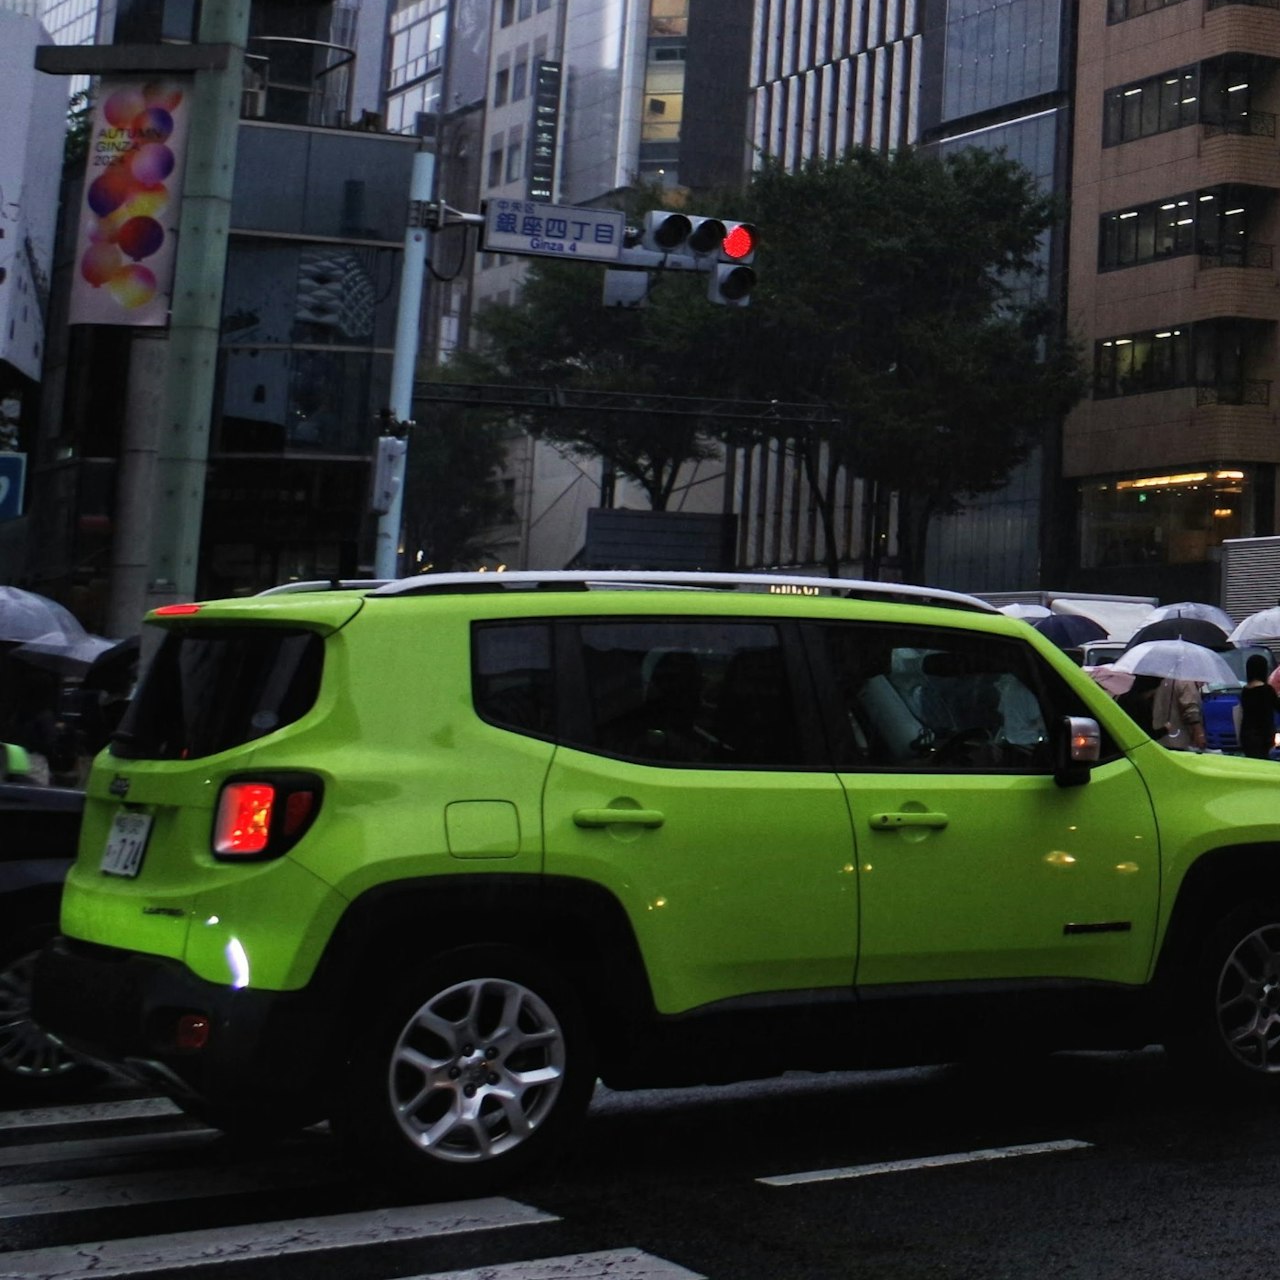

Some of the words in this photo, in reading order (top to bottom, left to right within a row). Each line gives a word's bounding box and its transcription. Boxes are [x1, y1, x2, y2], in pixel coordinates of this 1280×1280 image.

[497, 201, 535, 215] 中央区
[495, 212, 614, 244] 銀座四丁目
[530, 237, 564, 252] Ginza
[569, 242, 577, 252] 4
